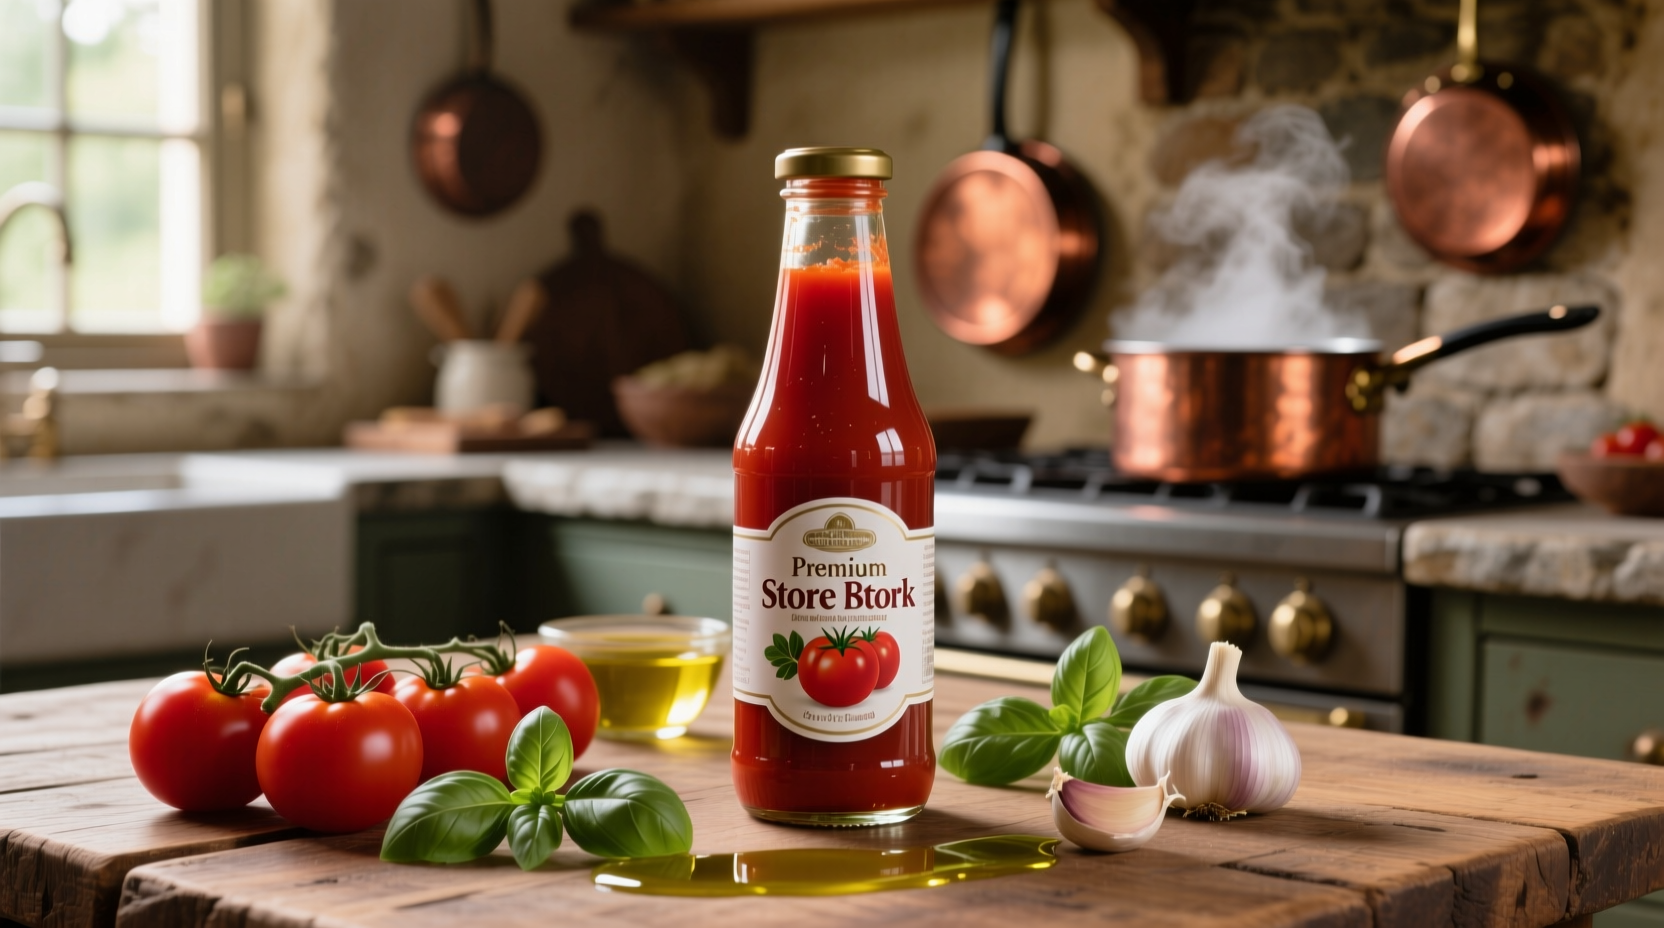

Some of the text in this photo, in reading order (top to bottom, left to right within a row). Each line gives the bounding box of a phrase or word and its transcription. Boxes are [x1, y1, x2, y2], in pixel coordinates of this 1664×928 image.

[792, 556, 887, 577] Premium
[762, 577, 916, 610] Store Btork
